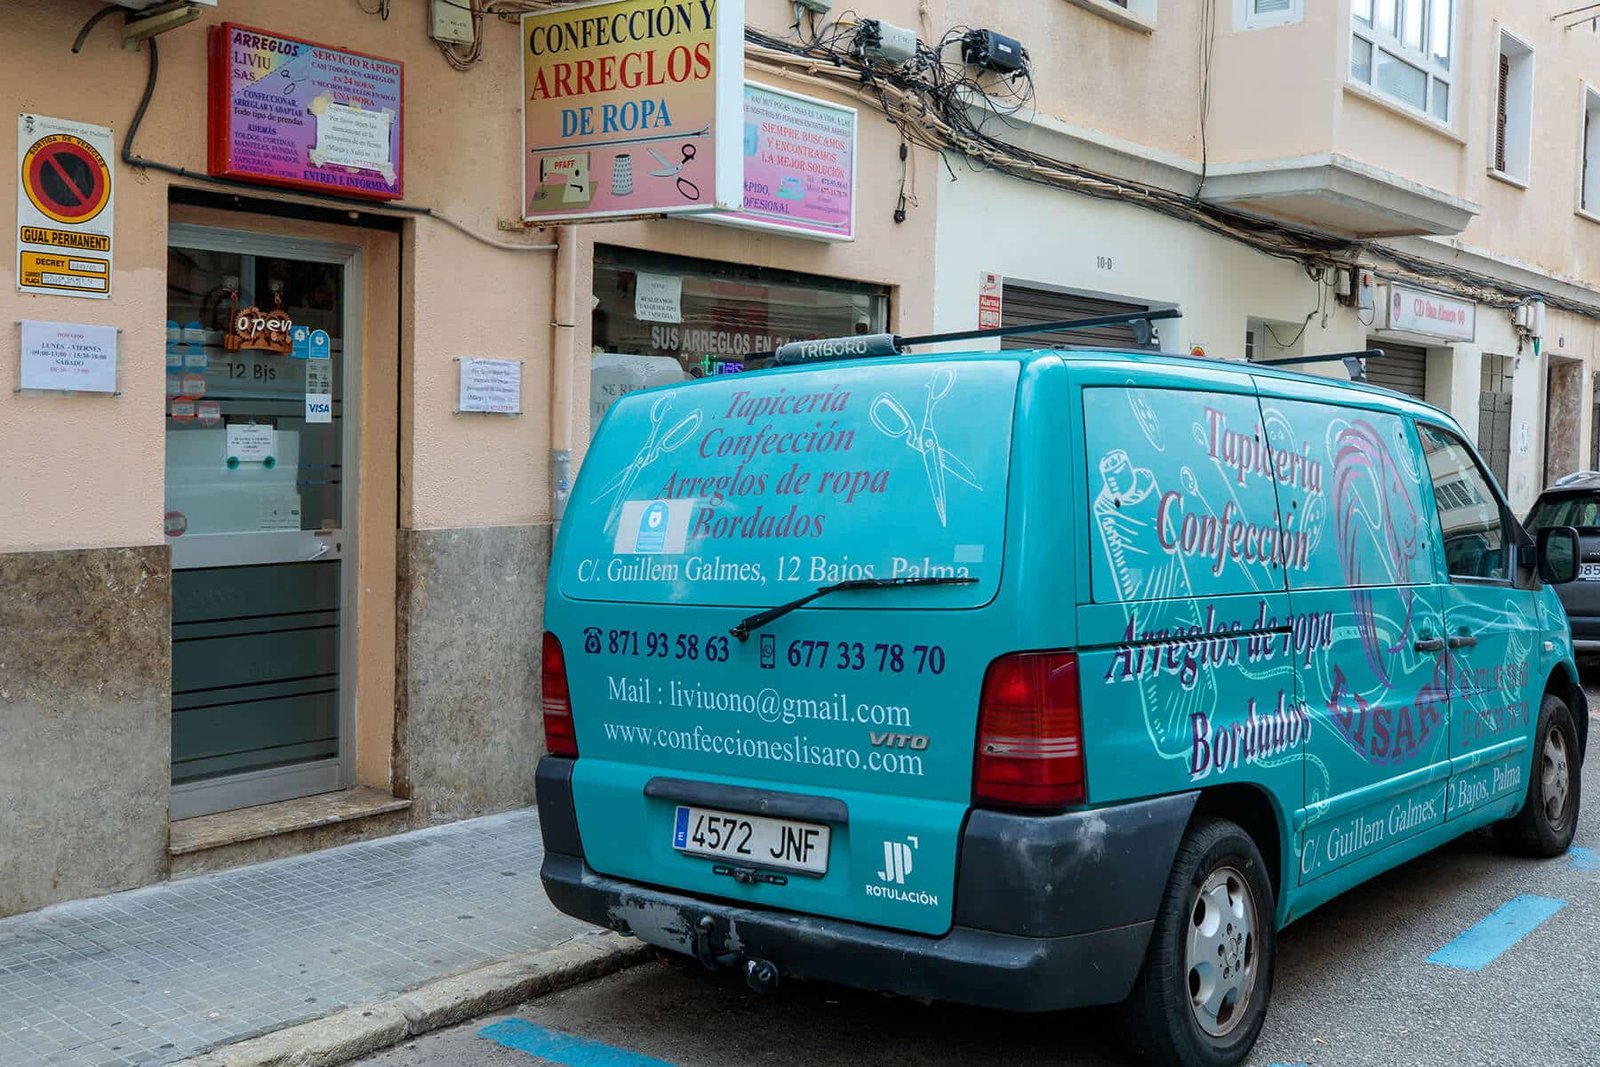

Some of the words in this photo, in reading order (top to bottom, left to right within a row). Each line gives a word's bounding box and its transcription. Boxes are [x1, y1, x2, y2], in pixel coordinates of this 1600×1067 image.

[529, 0, 692, 56] CONFECCIÓN
[699, 0, 717, 30] Y
[233, 32, 300, 57] ARREGLOS
[234, 51, 271, 70] LIVIU
[312, 49, 360, 68] SERVICIO
[234, 68, 256, 81] SAS
[328, 65, 349, 74] TODOS
[364, 73, 396, 84] ARREGLOS
[343, 76, 352, 85] 24
[354, 80, 376, 90] HORAS
[530, 42, 712, 101] ARREGLOS
[234, 99, 267, 110] ARREGLAR
[276, 106, 303, 117] ADAPTAR
[333, 91, 349, 101] UNA
[352, 97, 375, 106] HORA
[233, 107, 251, 116] Todo
[252, 110, 266, 120] tipo
[277, 115, 303, 126] prendas
[561, 106, 594, 138] DE
[602, 98, 672, 134] ROPA
[762, 121, 800, 139] SIEMPRE
[30, 136, 57, 155] SORTIDA
[77, 139, 105, 168] VEHICLES
[767, 137, 773, 148] Y
[776, 140, 837, 162] ENCONTRAMOS
[554, 159, 575, 170] PFAFF
[762, 152, 774, 164] LA
[777, 155, 805, 171] MEJOR
[807, 162, 844, 178] SOLUCIÓN
[304, 171, 336, 183] ENTREN
[340, 175, 345, 184] E
[744, 196, 790, 214] OFESIONAL
[24, 229, 49, 243] GUAL
[51, 232, 107, 249] PERMANENT
[36, 258, 65, 267] DECRET
[238, 316, 292, 338] open
[651, 328, 679, 350] SUS
[682, 330, 750, 354] ARREGLOS
[755, 335, 771, 353] EN
[227, 363, 246, 379] 12
[253, 364, 276, 383] Bjs
[602, 384, 615, 396] SE
[309, 404, 329, 413] VISA
[722, 384, 852, 426] Tapicería
[700, 421, 856, 464] Confección
[654, 464, 766, 505] Arreglos
[776, 458, 810, 494] de
[818, 467, 889, 501] ropa
[692, 504, 826, 540] Bordados
[1157, 490, 1311, 577] Confección
[577, 559, 600, 583] C/.
[607, 557, 679, 583] Guillem
[685, 556, 767, 585] Galmes,
[776, 556, 801, 581] 12
[891, 557, 970, 580] Palma
[608, 629, 640, 656] 871
[647, 632, 669, 658] 93
[675, 633, 699, 660] 58
[705, 635, 730, 663] 63
[787, 639, 829, 670] 677
[836, 642, 865, 671] 33
[874, 643, 904, 673] 78
[914, 645, 946, 675] 70
[1104, 603, 1242, 690] Arreglos
[1248, 600, 1279, 663] de
[1284, 610, 1334, 669] ropa
[608, 677, 650, 705] Mail
[670, 680, 911, 728] liviuono@gmail.com
[869, 731, 931, 751] VITO
[1188, 689, 1312, 782] Bordados
[603, 720, 924, 777] www.confeccioneslisaro.com
[1302, 835, 1321, 874] C/.
[1326, 816, 1384, 862] Guillem
[1388, 798, 1437, 835] Galmes,
[1442, 786, 1456, 814] 12
[1458, 777, 1490, 811] Bajos,
[1492, 765, 1521, 795] Palma
[678, 832, 684, 841] E
[692, 815, 754, 854] 4572
[770, 826, 820, 863] JNF
[866, 884, 938, 906] ROTULACIÓN
